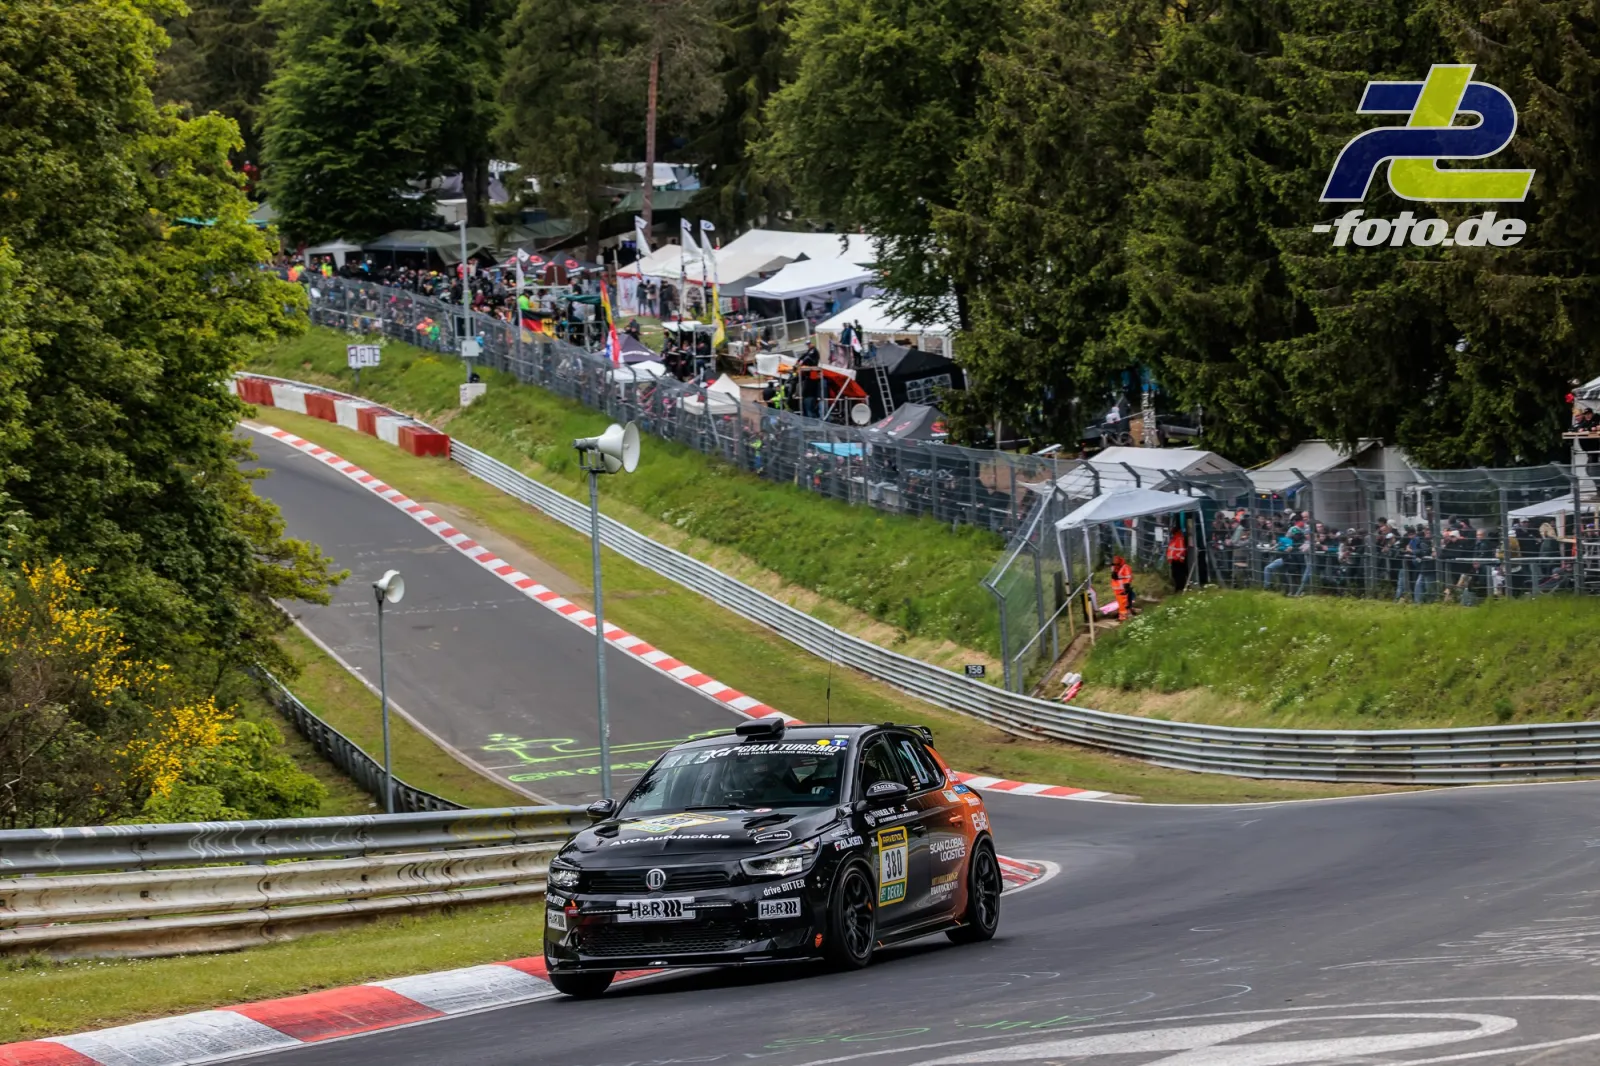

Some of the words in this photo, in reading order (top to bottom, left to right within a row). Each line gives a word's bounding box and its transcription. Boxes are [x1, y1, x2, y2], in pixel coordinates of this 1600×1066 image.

[968, 665, 983, 674] 158
[738, 744, 778, 753] GRAN
[779, 743, 840, 753] TURISMO
[834, 835, 863, 851] FALKEN
[930, 841, 944, 854] SCAN
[944, 837, 964, 850] GLOBAL
[940, 847, 966, 861] LOGISTICS
[885, 848, 903, 879] 380
[763, 886, 781, 896] drive
[781, 879, 805, 891] BITTER
[887, 884, 904, 900] DEKRA
[629, 901, 661, 917] H&R
[760, 902, 783, 916] H&R
